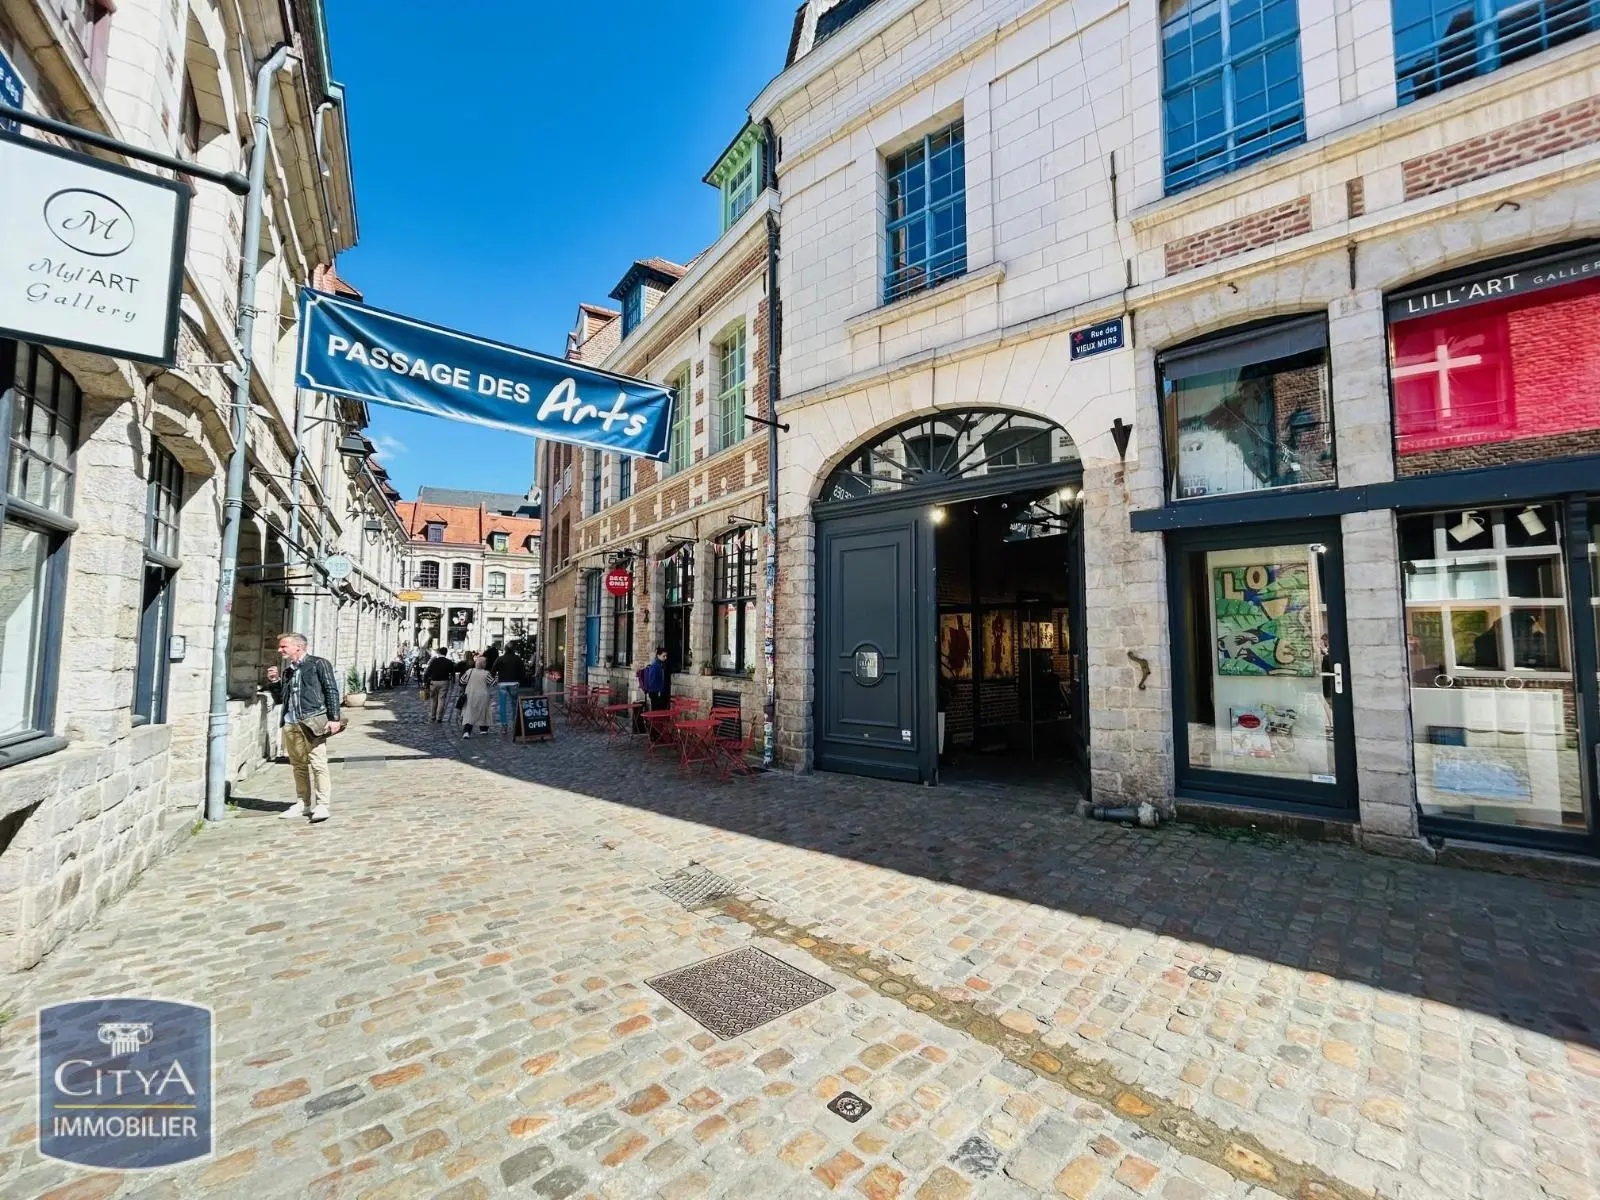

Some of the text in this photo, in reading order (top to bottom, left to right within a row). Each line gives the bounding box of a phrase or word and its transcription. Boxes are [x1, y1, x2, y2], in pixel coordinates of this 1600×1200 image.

[26, 282, 137, 323] Gallery
[1408, 273, 1519, 313] LILL'ART
[1076, 336, 1117, 353] VIEUX MURS
[1091, 325, 1117, 338] Rue des
[327, 334, 648, 437] PASSAGE DES Arts
[528, 720, 547, 728] OPEN
